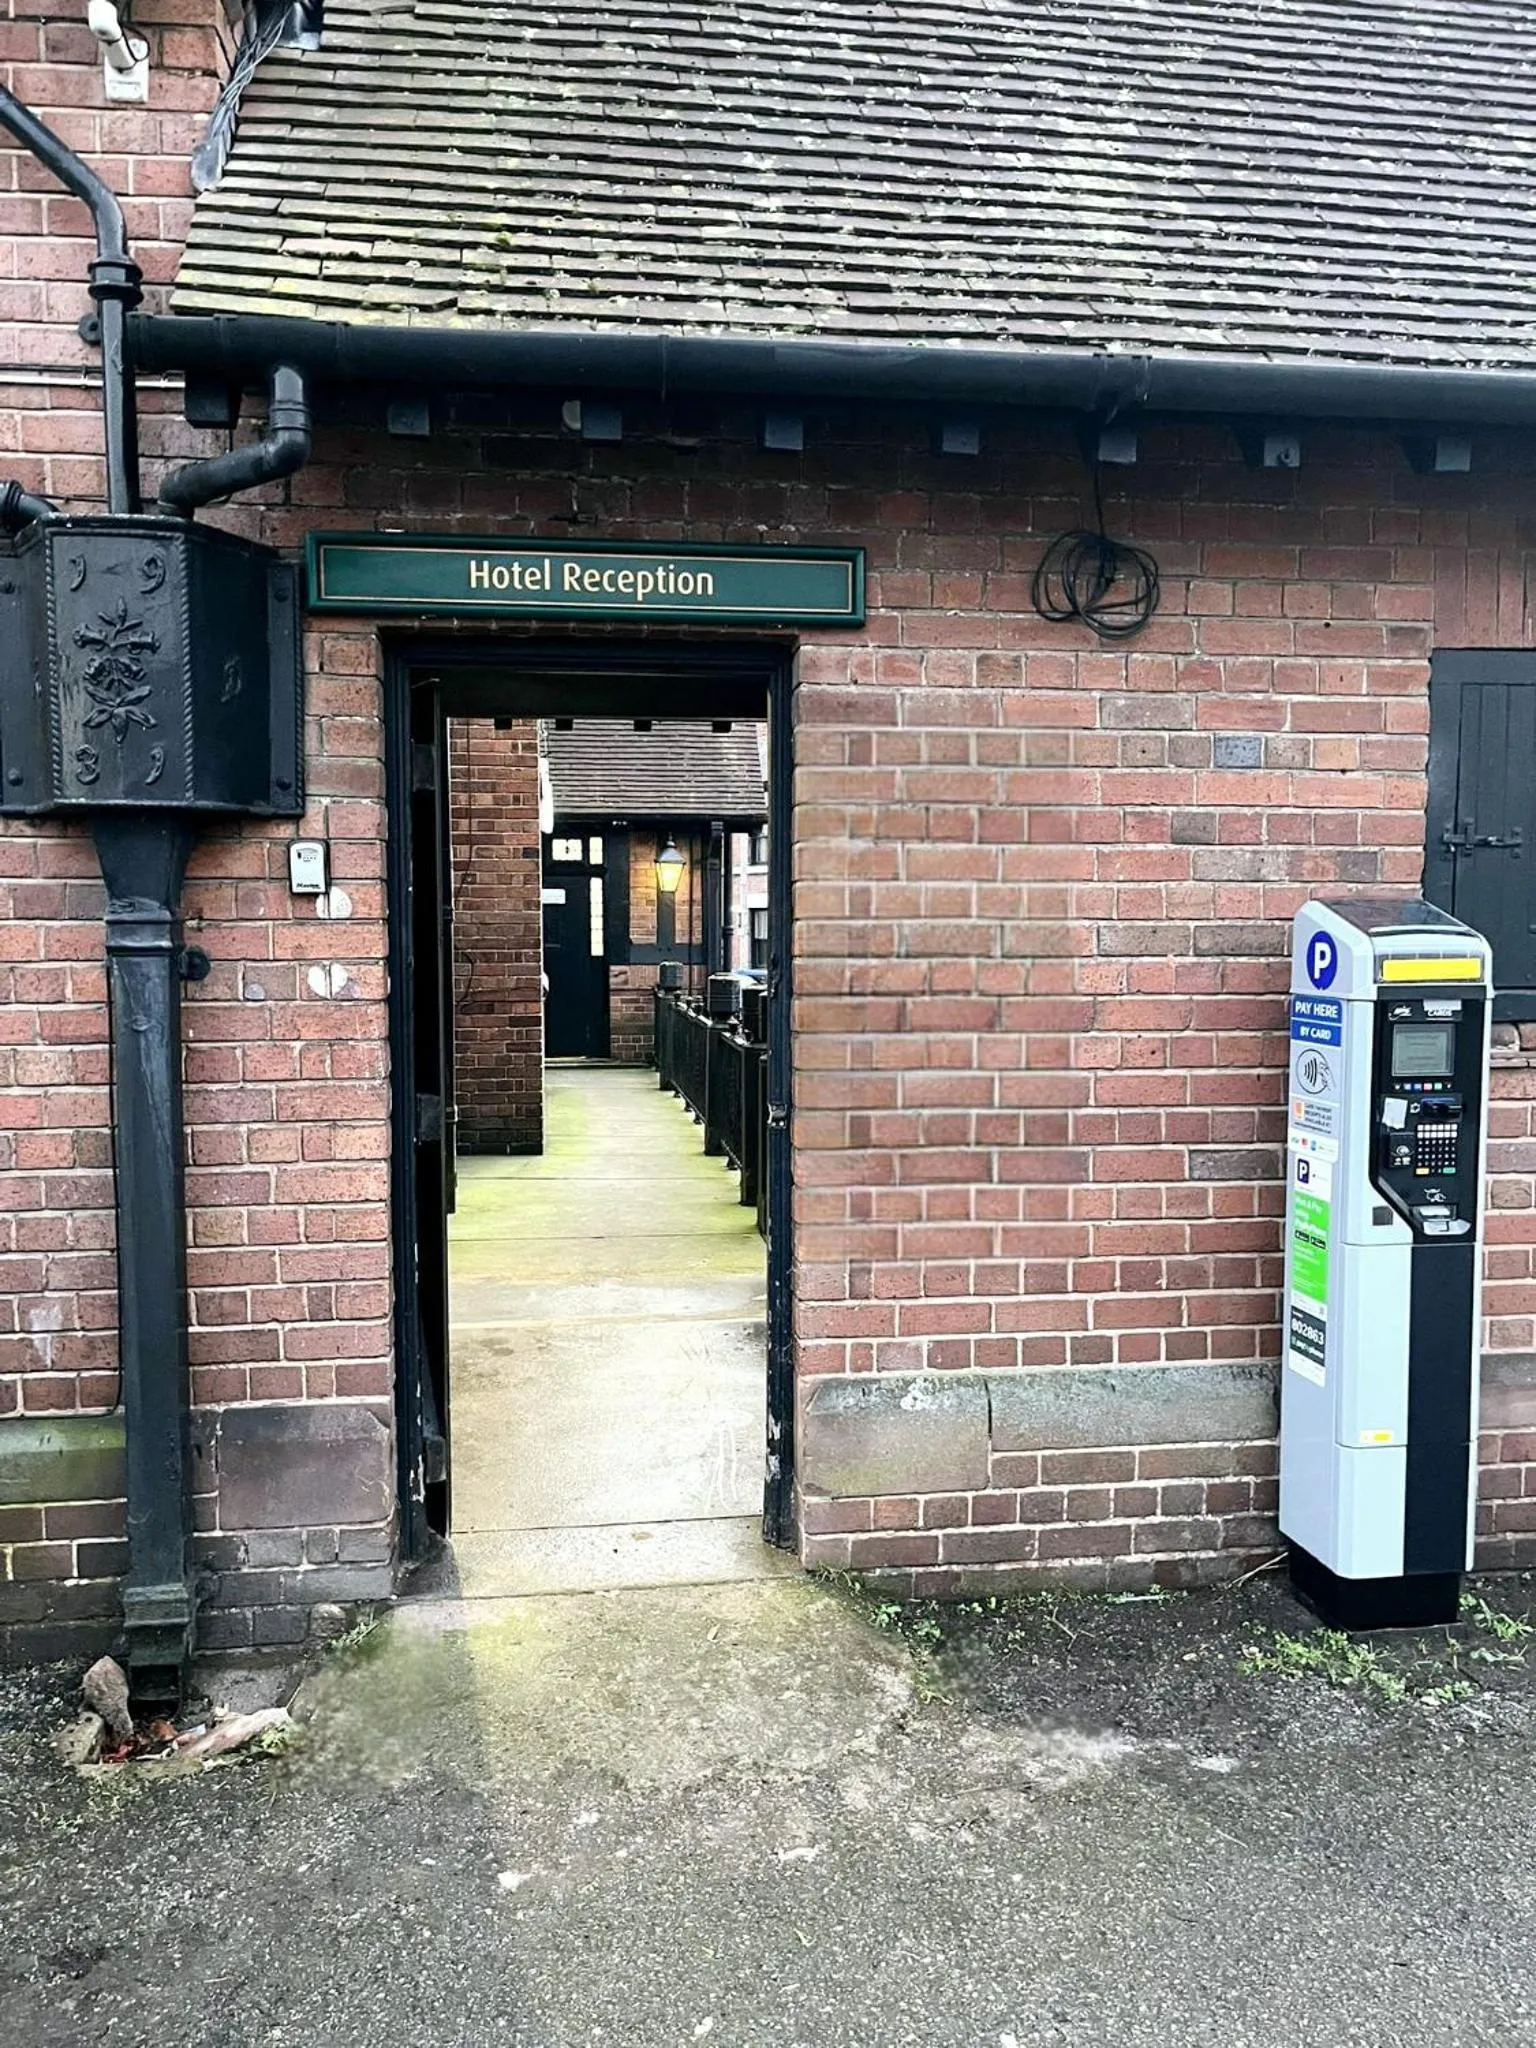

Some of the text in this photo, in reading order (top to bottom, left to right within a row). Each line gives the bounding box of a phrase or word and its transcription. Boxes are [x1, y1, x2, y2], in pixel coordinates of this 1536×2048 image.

[470, 558, 714, 601] Hotel Reception
[1314, 942, 1332, 979] P
[1295, 1001, 1339, 1018] PAY HERE
[1300, 1026, 1332, 1040] BY CARD
